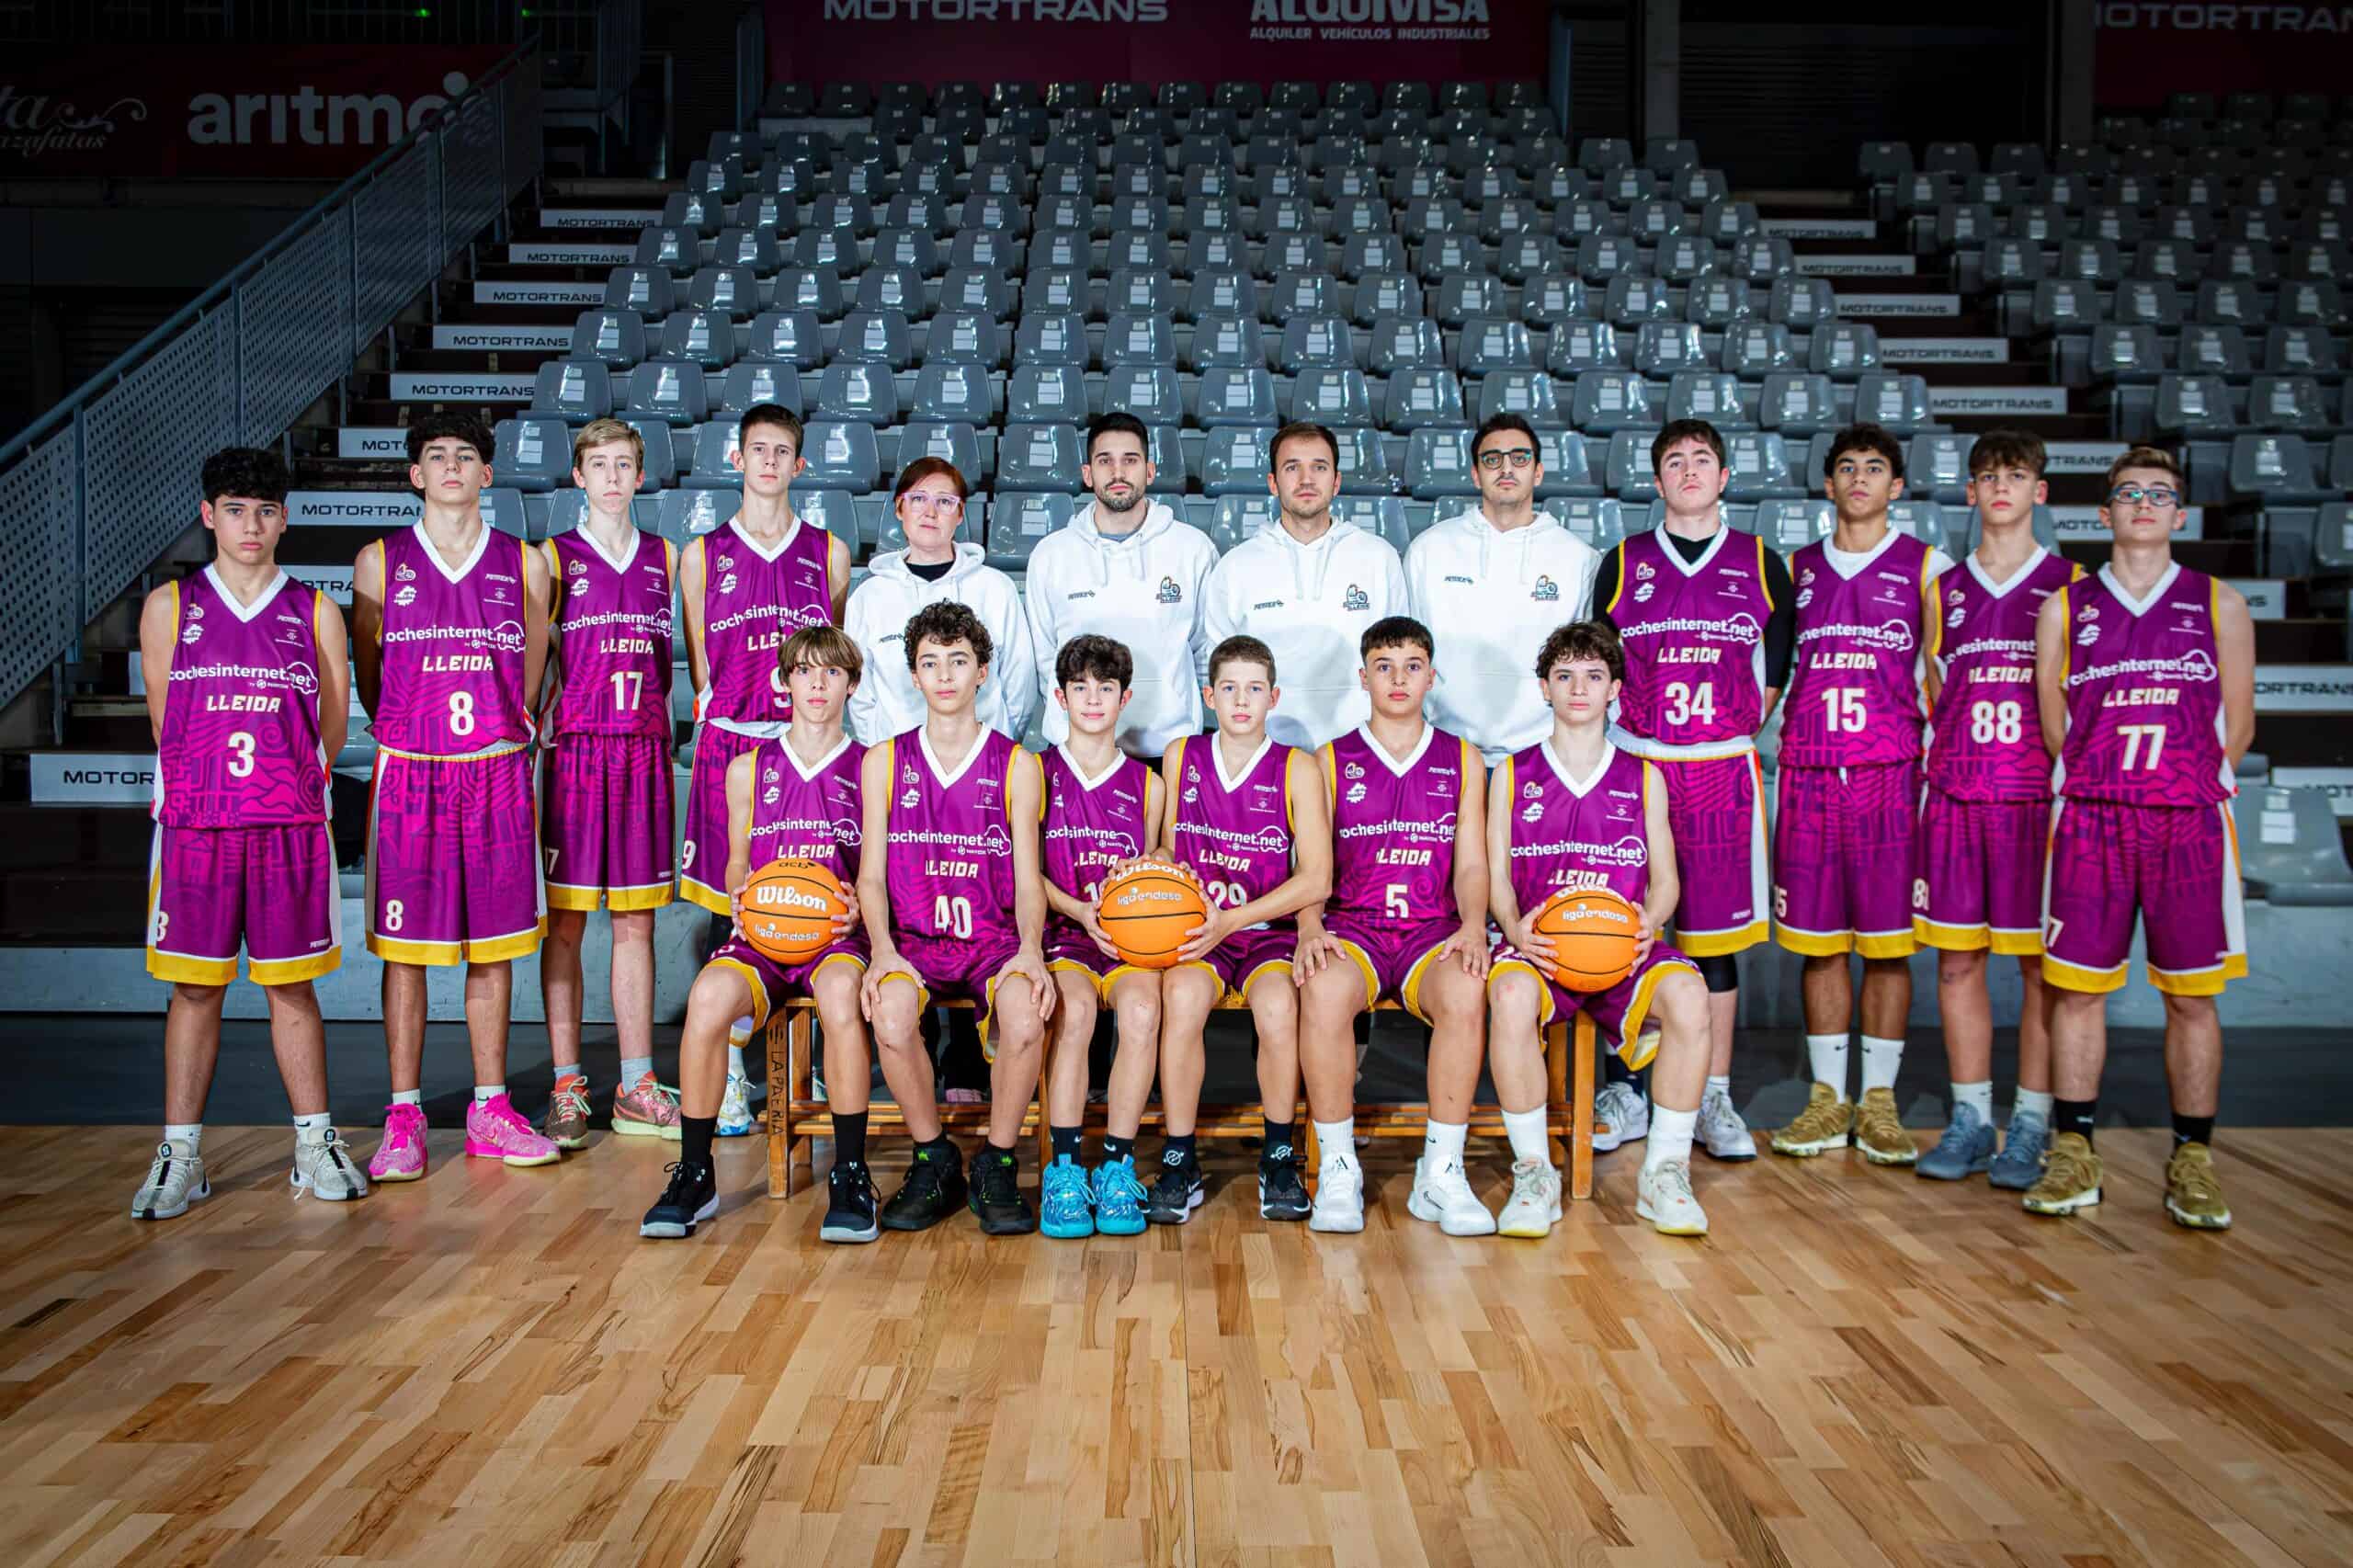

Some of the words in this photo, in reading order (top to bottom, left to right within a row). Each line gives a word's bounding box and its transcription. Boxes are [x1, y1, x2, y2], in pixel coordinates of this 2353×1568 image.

[824, 0, 1168, 22] MOTORTRANS
[2095, 2, 2353, 32] OTORTRA
[1250, 28, 1313, 41] ALQUILER
[1397, 28, 1490, 40] INDUSTRIALES
[527, 253, 630, 263] MOTORTRANS
[494, 290, 602, 301] MOTORTRANS
[452, 336, 569, 347] MOTORTRANS
[412, 384, 534, 396] MOTORTRANS
[301, 505, 421, 516] MOTORTRA
[600, 638, 654, 655] LLEIDA
[1657, 646, 1722, 665] LLEIDA
[422, 655, 494, 672] LLEIDA
[1810, 653, 1878, 670] LLEIDA
[610, 671, 643, 711] 17
[2102, 687, 2180, 708] LLEIDA
[207, 694, 281, 713] LLEIDA
[449, 691, 475, 736] 8
[1665, 681, 1716, 726] 34
[1821, 687, 1867, 733] 15
[1971, 700, 2023, 744] 88
[227, 732, 256, 778] 3
[2117, 724, 2167, 771] 77
[63, 770, 154, 785] MOTOR
[778, 845, 835, 858] LLEIDA
[1548, 869, 1609, 887] LEIDA
[756, 885, 826, 913] Wilson
[1384, 884, 1409, 919] 5
[384, 899, 404, 932] 8
[934, 894, 972, 939] 40
[2046, 915, 2064, 949] 7
